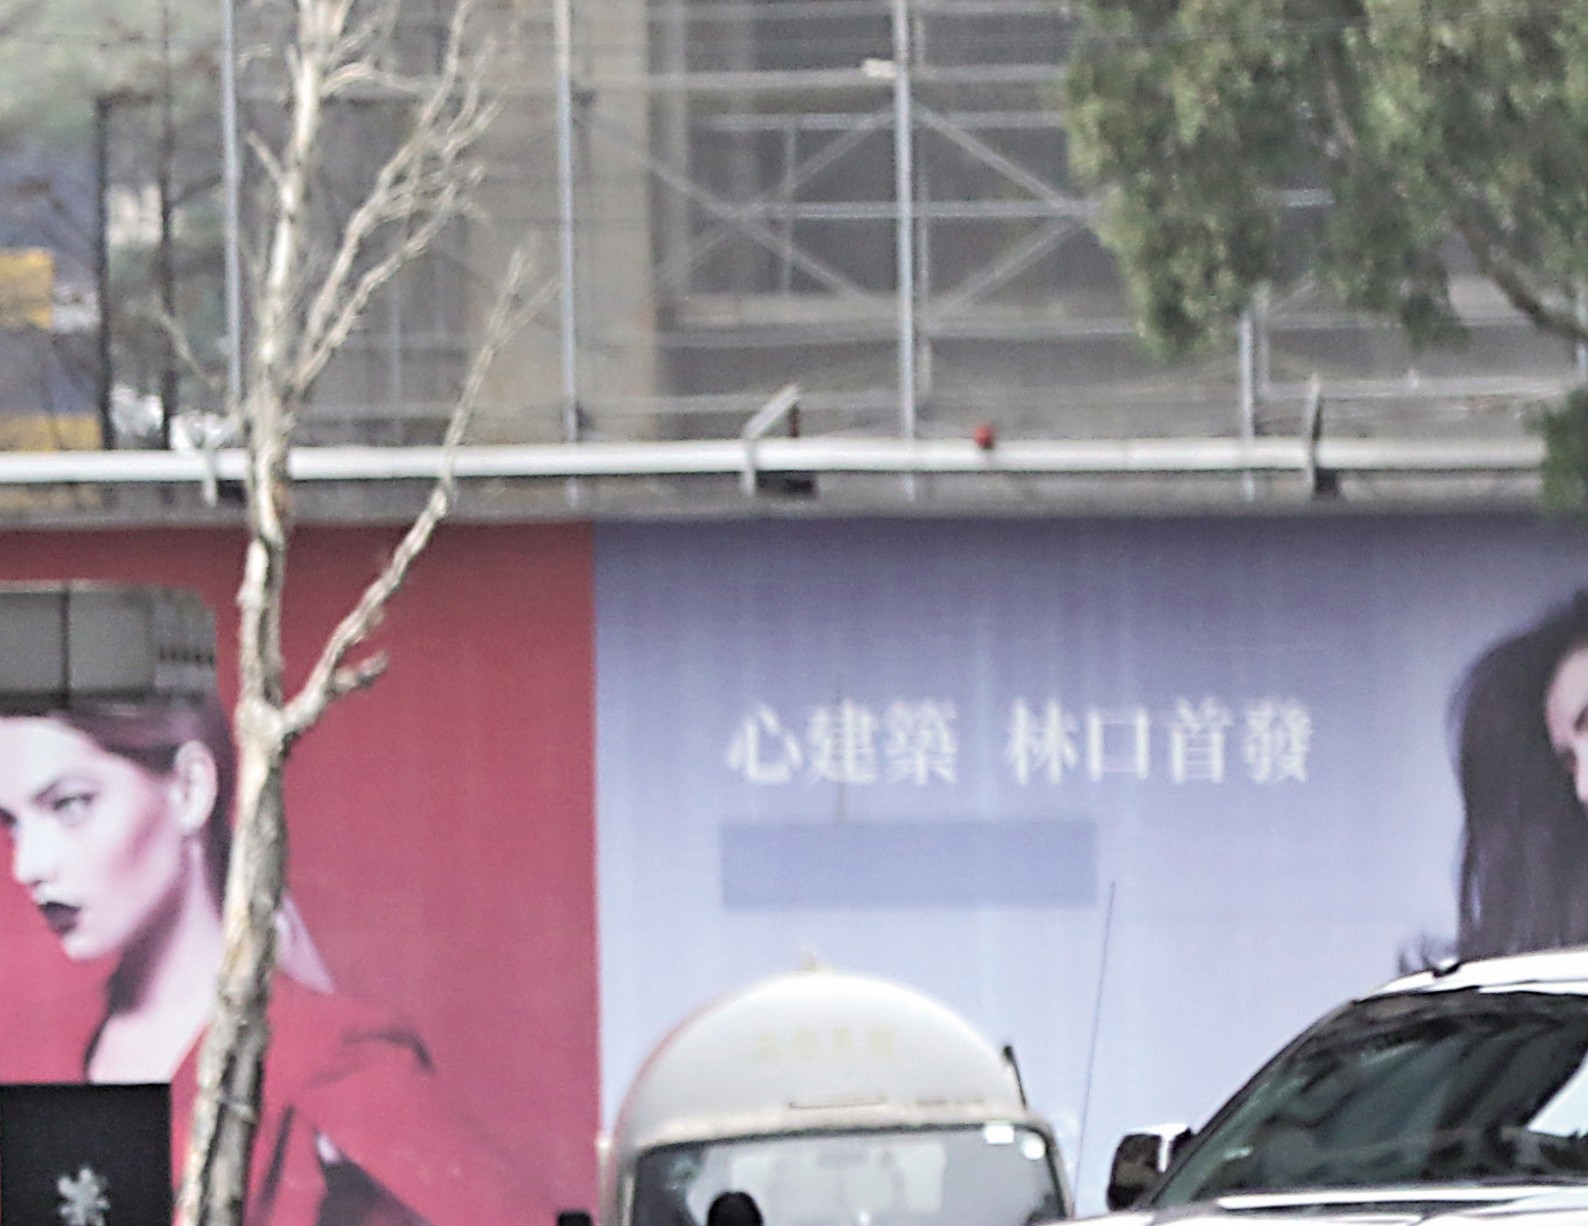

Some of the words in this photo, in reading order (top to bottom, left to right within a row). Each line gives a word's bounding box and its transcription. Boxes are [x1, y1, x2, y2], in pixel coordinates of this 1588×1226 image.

[724, 696, 957, 787] 心建築
[1004, 696, 1314, 787] 林口首發
